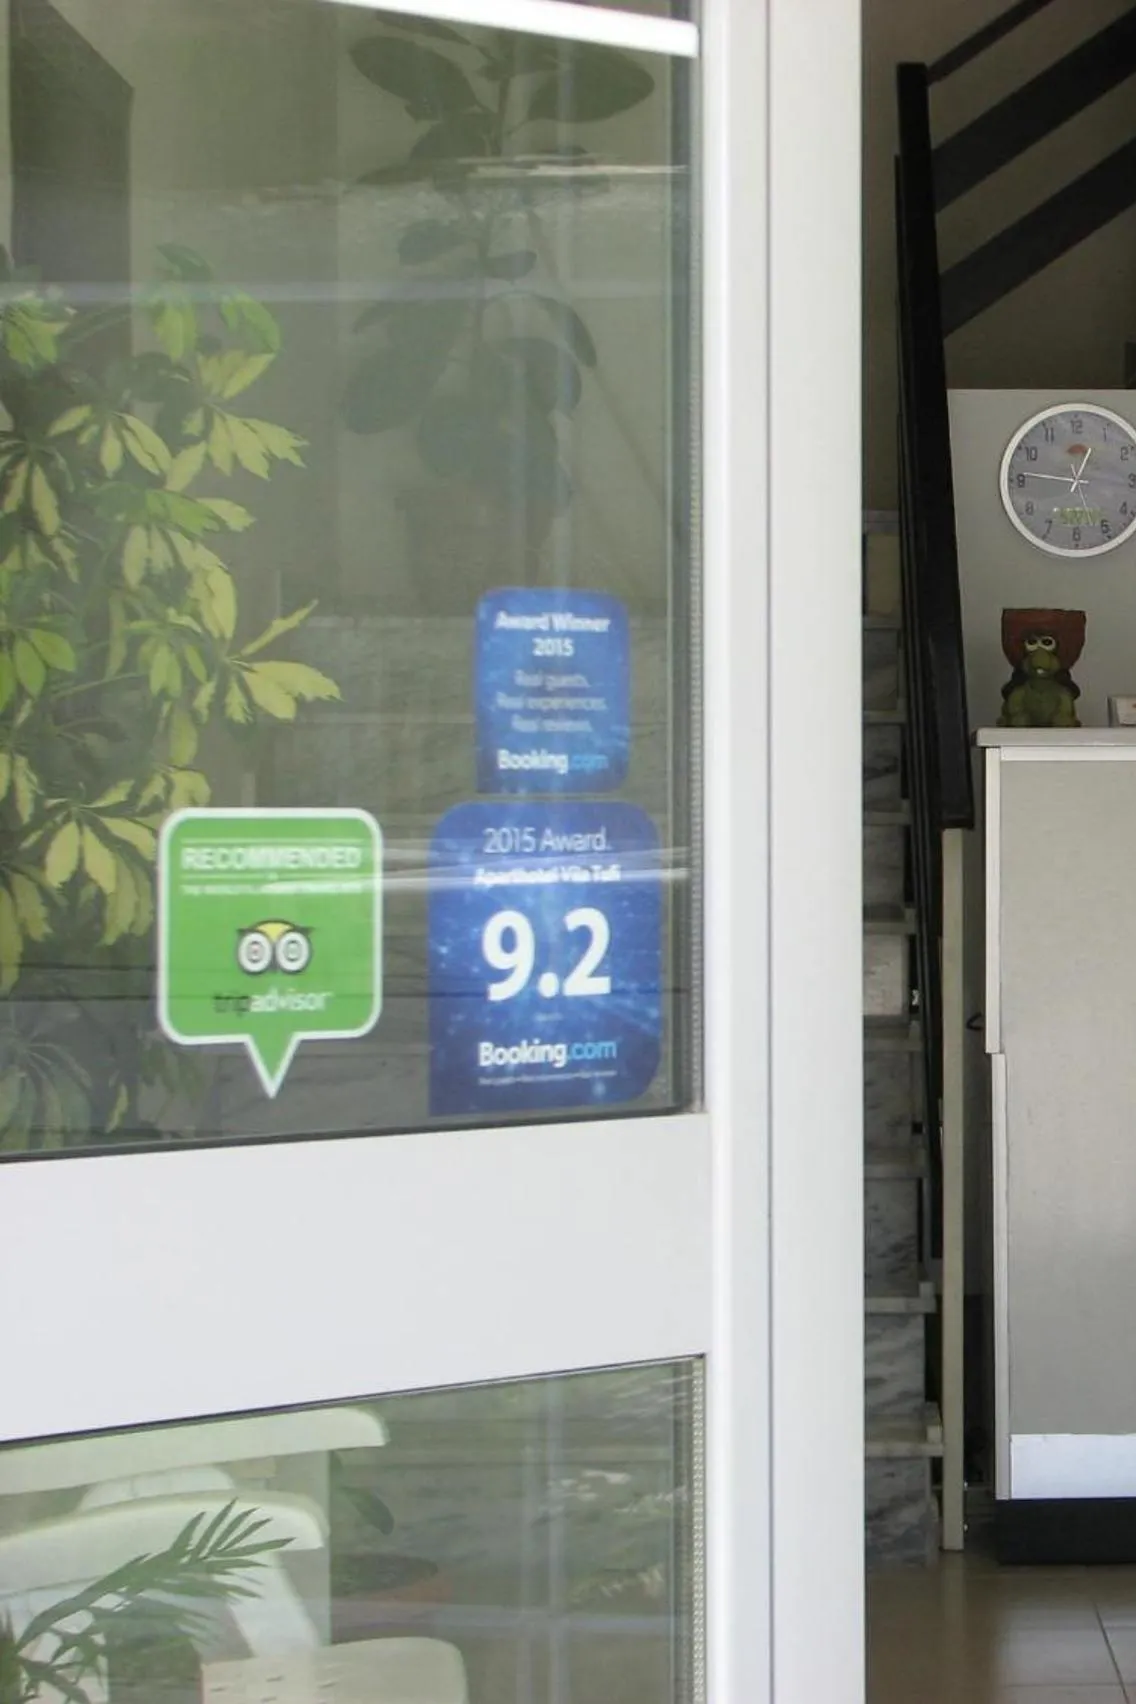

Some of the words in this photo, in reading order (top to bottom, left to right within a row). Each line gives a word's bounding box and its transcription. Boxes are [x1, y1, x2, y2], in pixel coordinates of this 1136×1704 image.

[1070, 419, 1083, 434] 12
[1045, 427, 1055, 442] 11
[1025, 446, 1038, 461] 10
[1120, 446, 1129, 461] 2
[1016, 473, 1026, 488] 9
[1128, 473, 1136, 488] 3
[1025, 501, 1034, 515] 8
[1119, 501, 1128, 515] 4
[1045, 519, 1053, 536] 7
[1072, 526, 1082, 541] 6
[1101, 519, 1111, 534] 5
[494, 610, 549, 631] Award
[551, 612, 611, 633] Winner
[532, 637, 574, 657] 2015
[496, 748, 609, 775] Booking.com
[483, 826, 536, 854] 2015
[181, 846, 362, 870] RECOMMENDED
[482, 906, 612, 1002] 9.2
[213, 986, 333, 1017] tripadvisor
[477, 1036, 617, 1068] Booking.com
